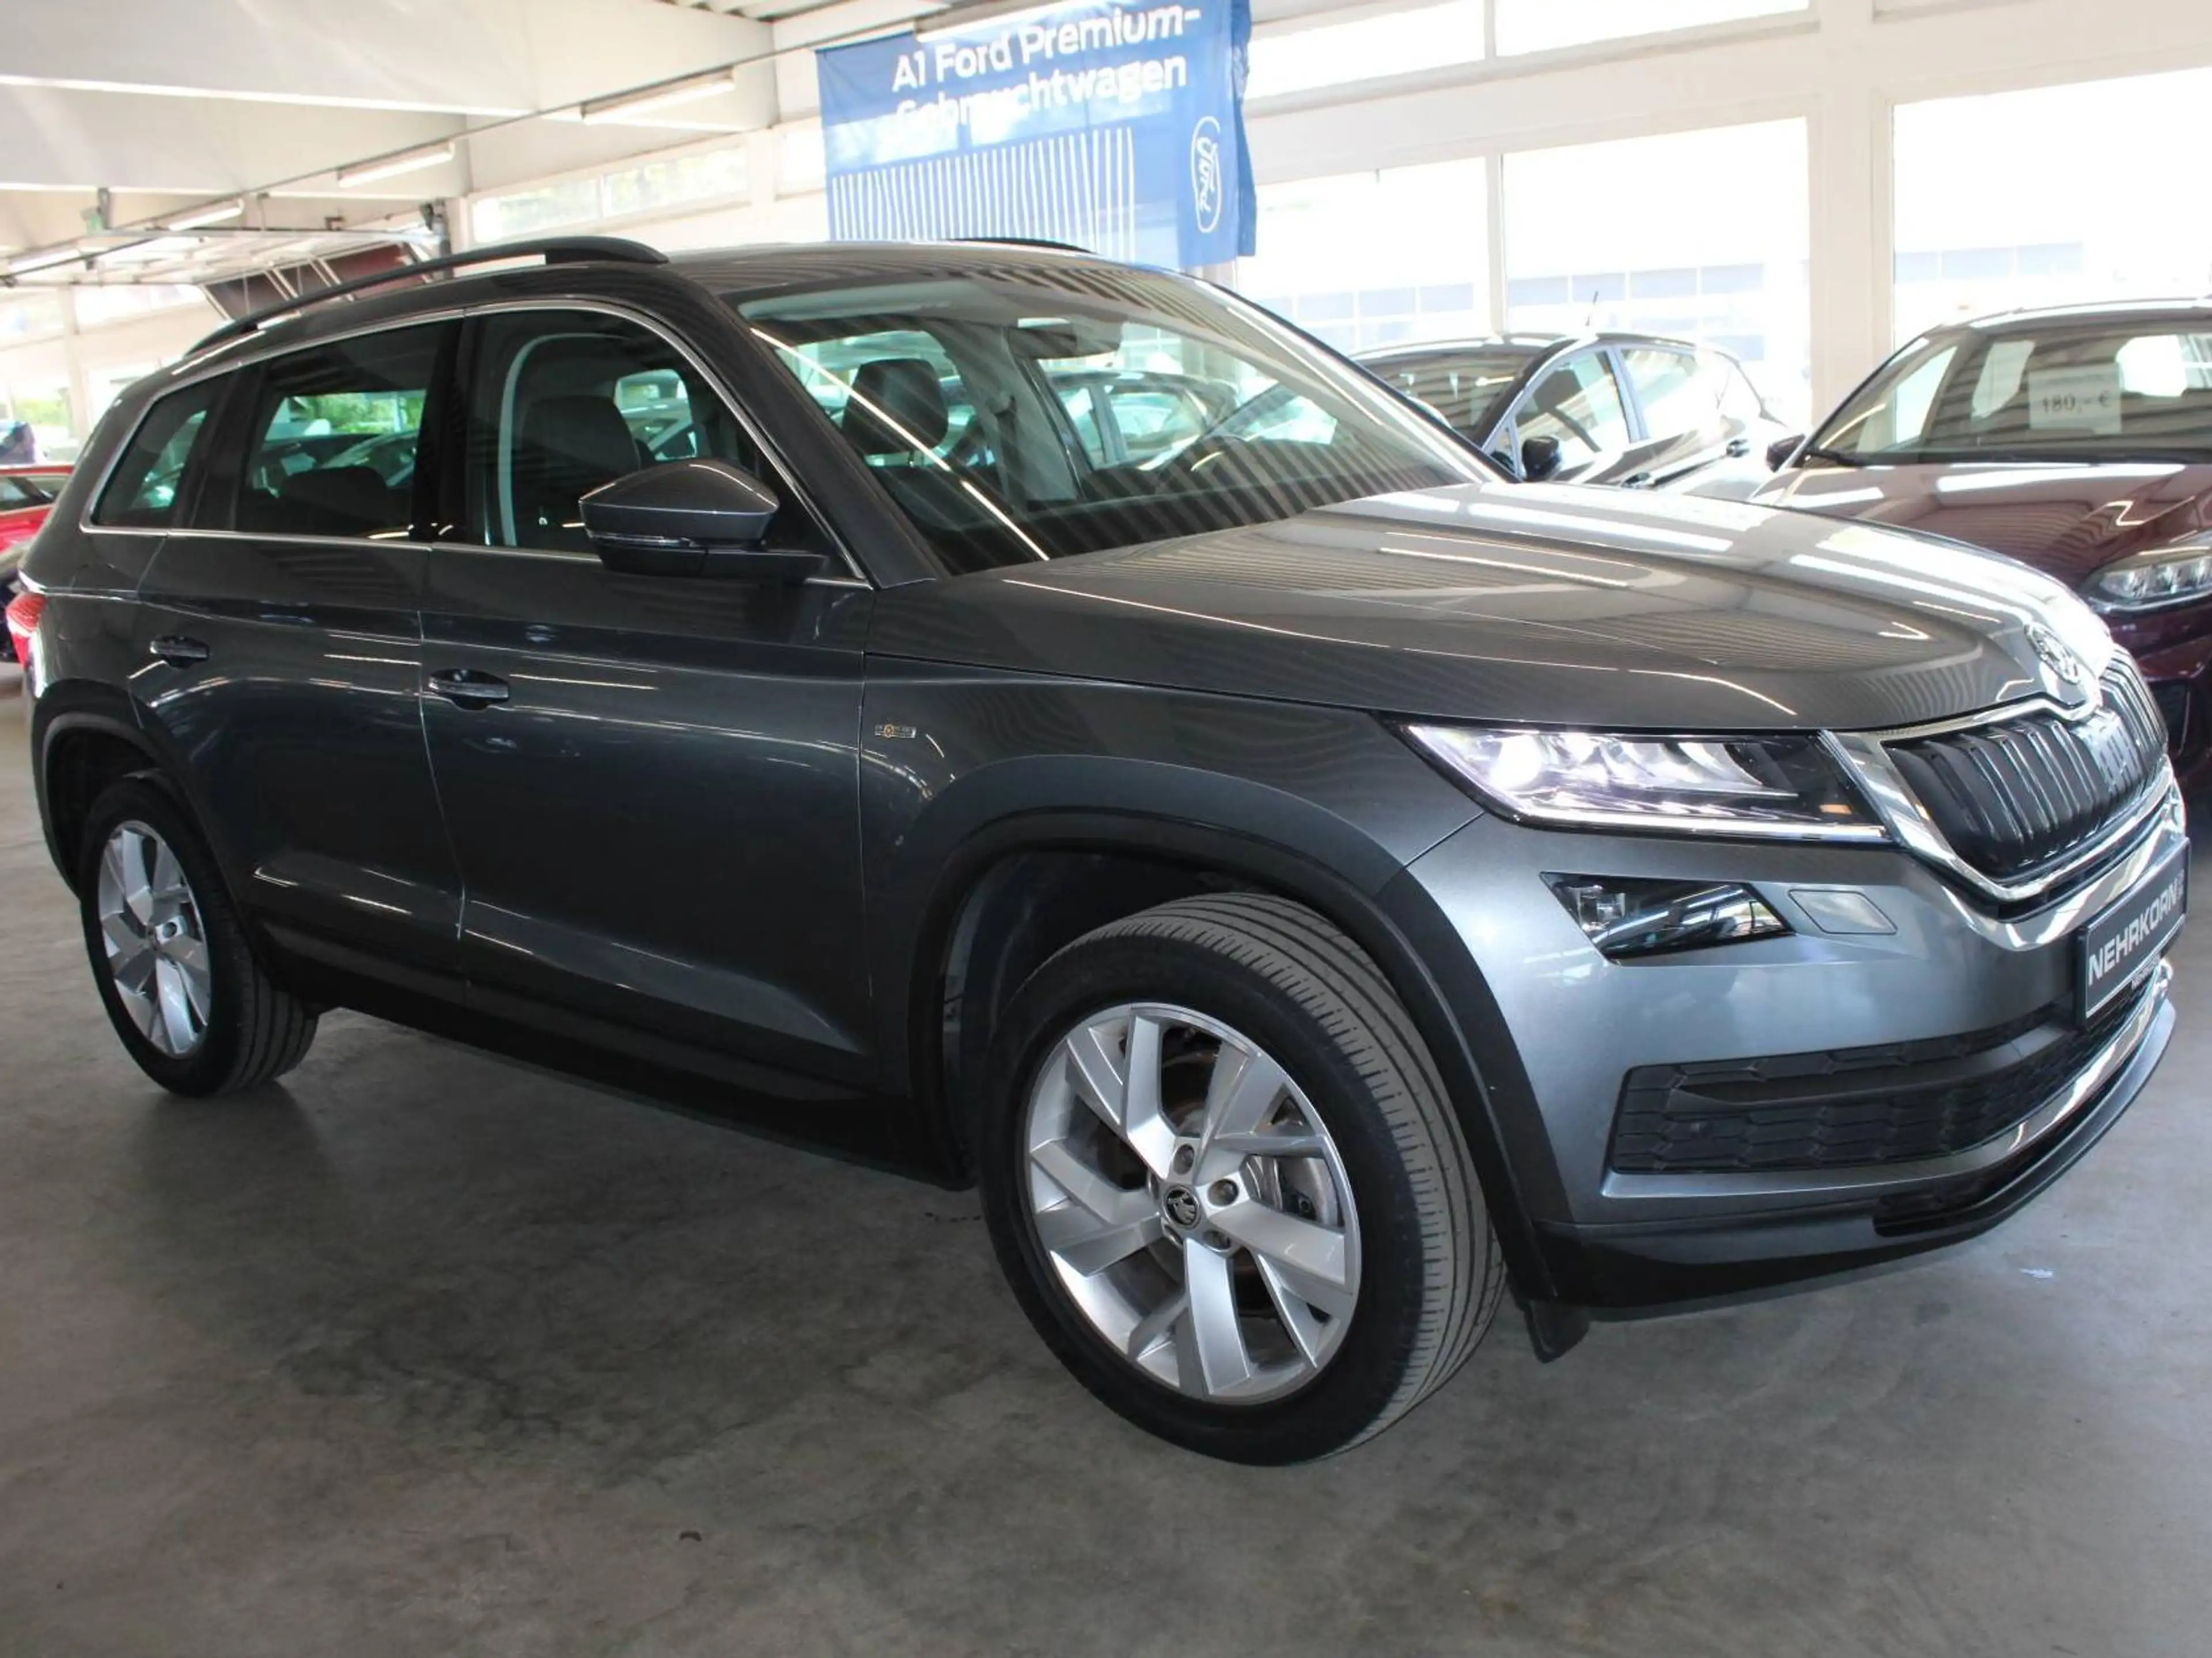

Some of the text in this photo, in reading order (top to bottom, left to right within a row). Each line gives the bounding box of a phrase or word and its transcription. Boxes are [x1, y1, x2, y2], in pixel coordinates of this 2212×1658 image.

[892, 5, 1202, 93] A1 Ford Premium-
[895, 55, 1187, 129] Gebrchtwagen
[2088, 878, 2178, 986] NEHRKORN
